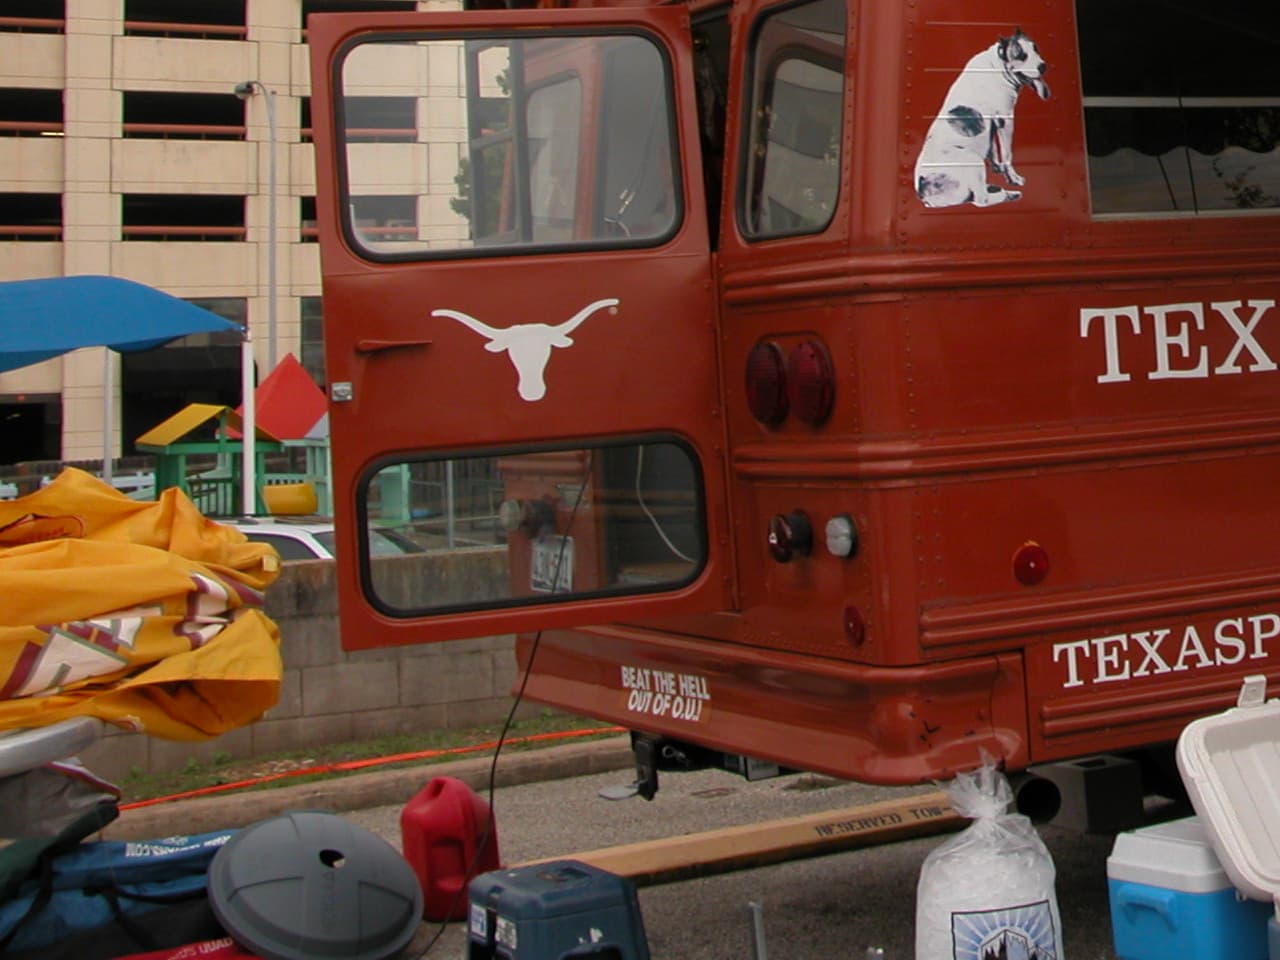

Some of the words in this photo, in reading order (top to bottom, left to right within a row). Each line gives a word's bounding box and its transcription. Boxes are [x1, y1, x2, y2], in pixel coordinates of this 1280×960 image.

[621, 665, 650, 690] BEAT
[652, 670, 677, 695] THE
[678, 674, 711, 700] HELL
[628, 689, 653, 713] OUT
[652, 693, 672, 717] OF
[814, 812, 903, 837] RESERVED
